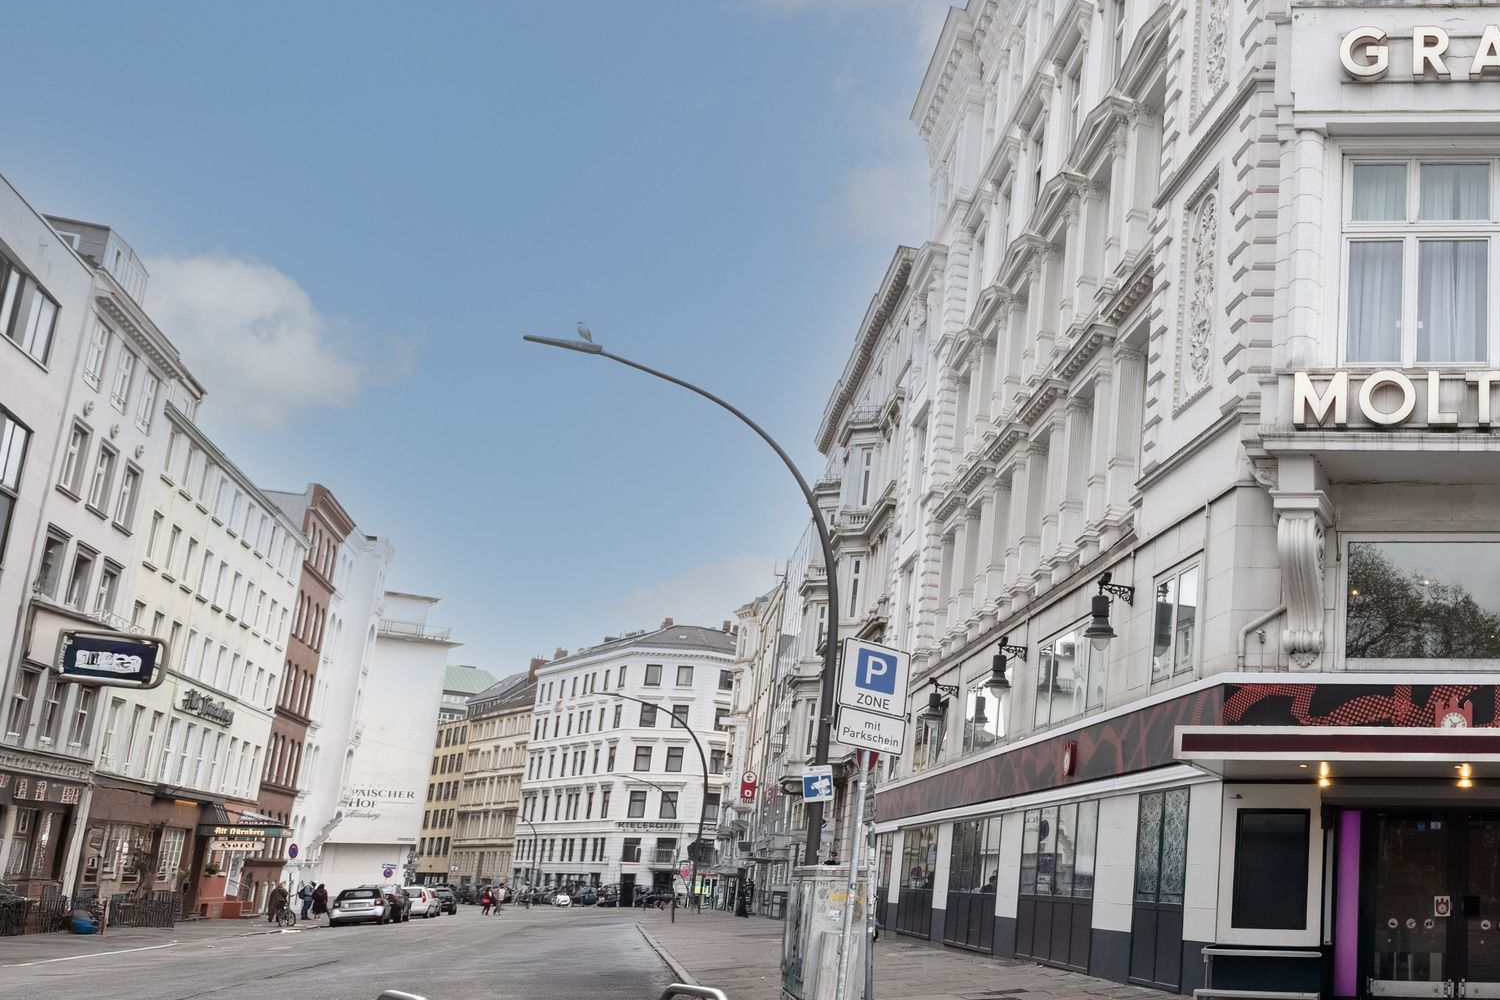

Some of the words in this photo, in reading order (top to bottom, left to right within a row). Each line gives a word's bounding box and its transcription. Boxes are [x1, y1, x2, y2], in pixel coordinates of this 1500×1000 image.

[865, 655, 888, 685] P
[856, 692, 890, 711] ZONE
[864, 720, 881, 731] mit
[842, 726, 899, 748] Parkschein
